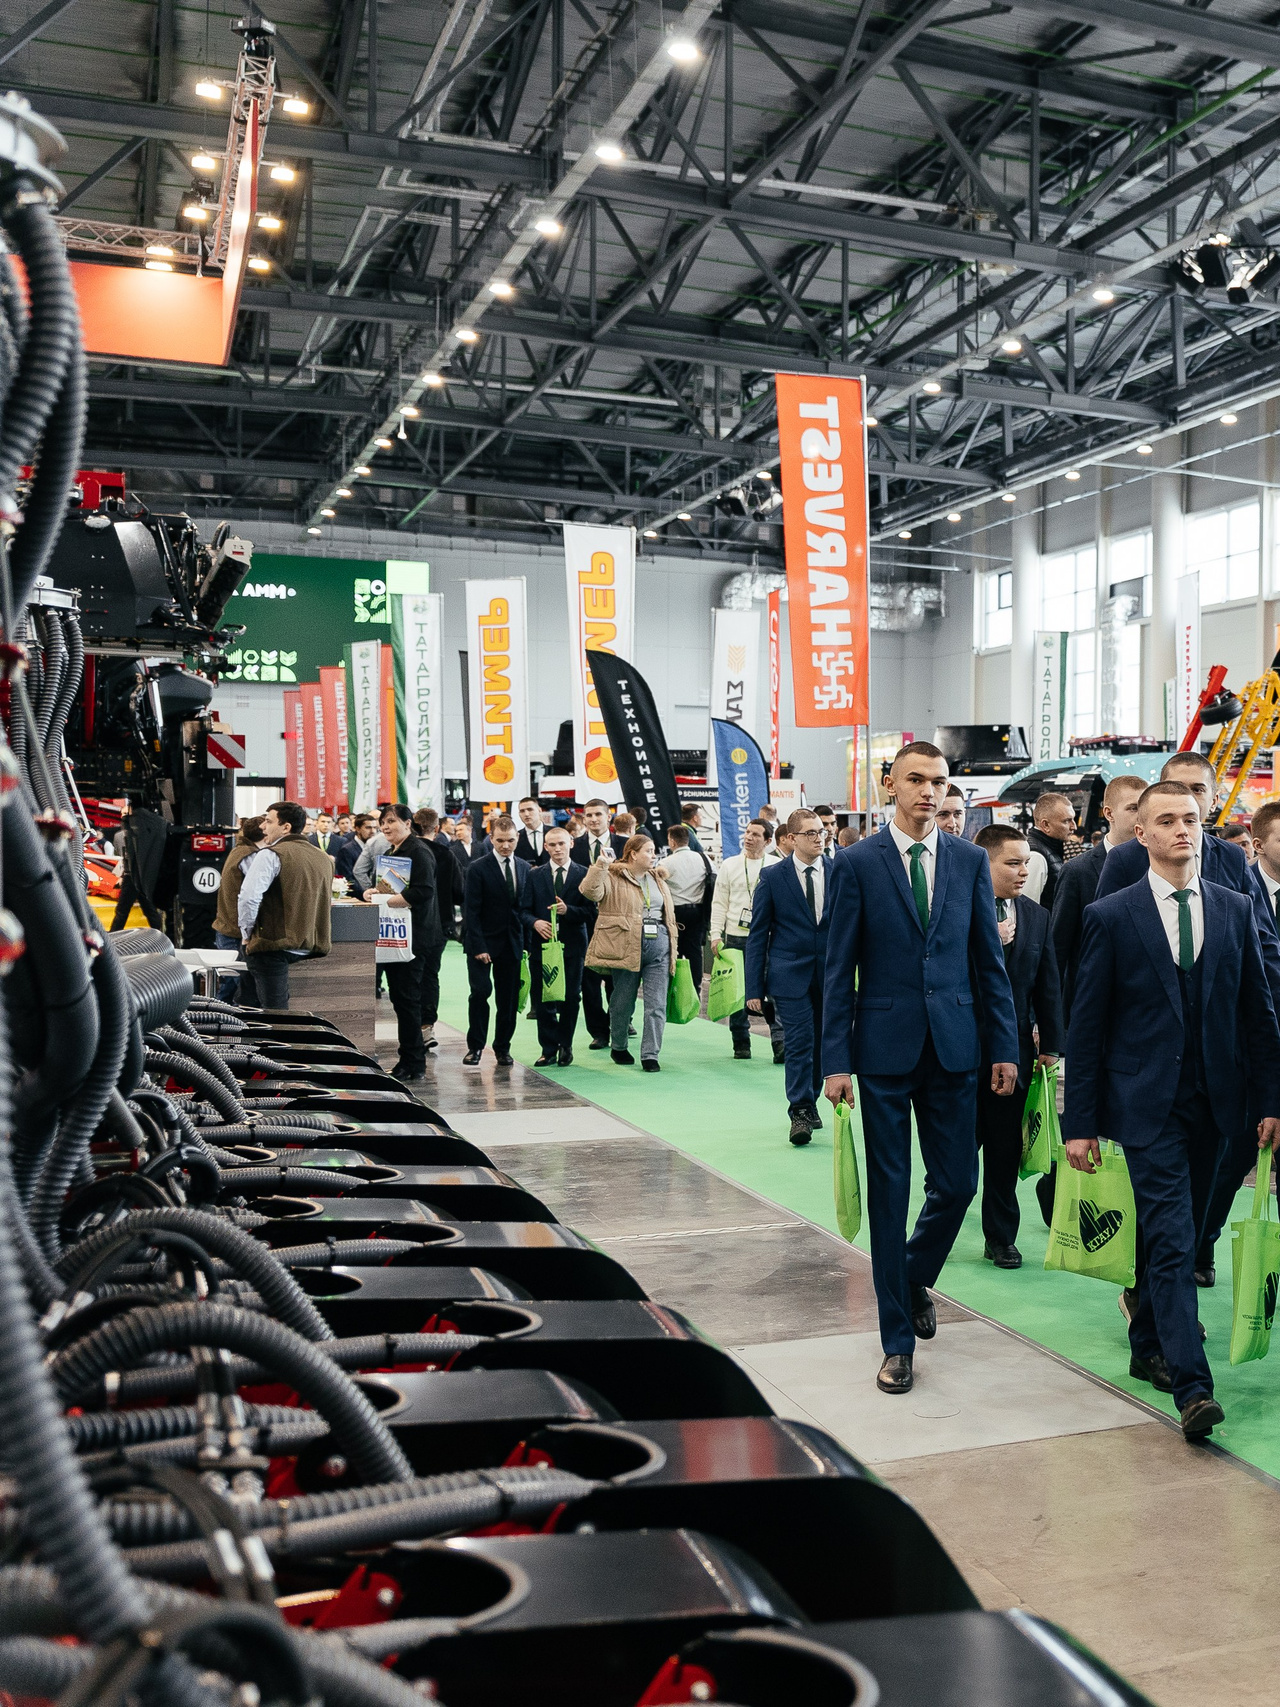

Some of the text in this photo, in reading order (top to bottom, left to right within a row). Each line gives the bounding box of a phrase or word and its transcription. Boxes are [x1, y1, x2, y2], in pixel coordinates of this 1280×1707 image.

[415, 621, 431, 789] ТАТАГРОЛИЗИНГ
[617, 679, 663, 831] ТЕХНОИНВЕСТ
[198, 872, 215, 887] 40
[1087, 1227, 1111, 1251] КГАУ
